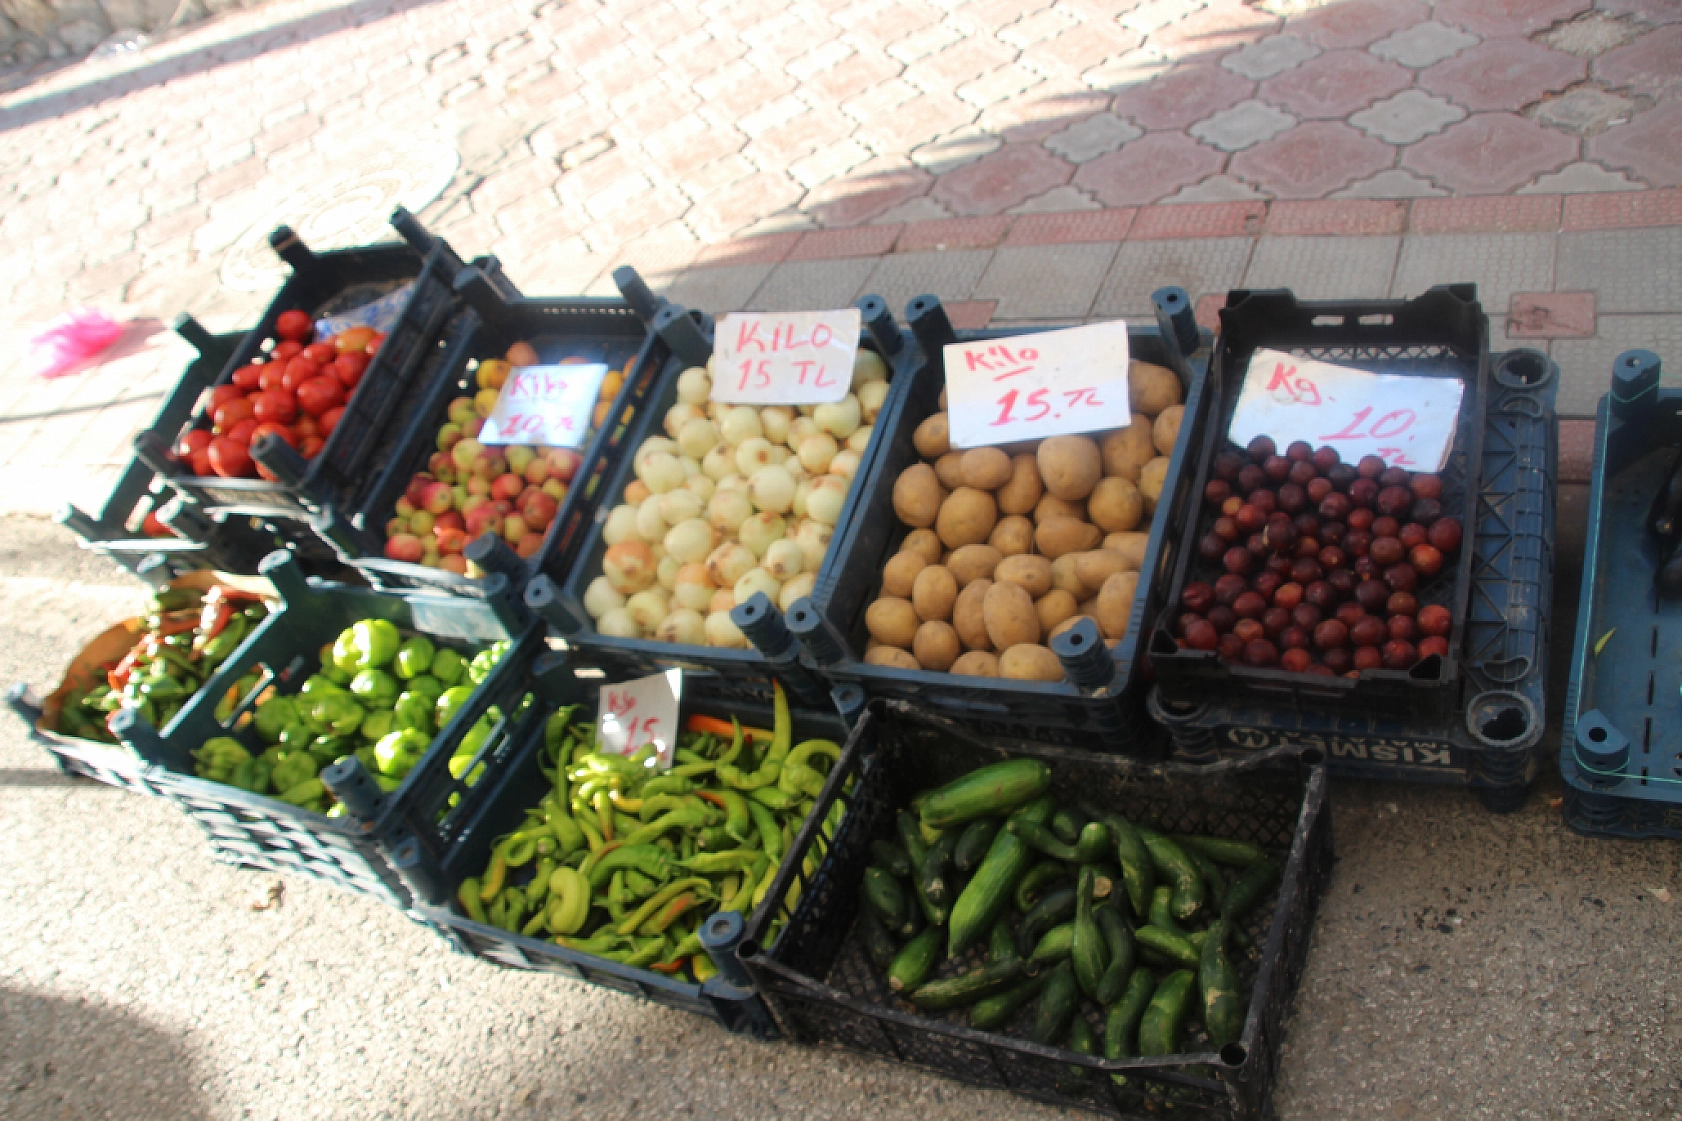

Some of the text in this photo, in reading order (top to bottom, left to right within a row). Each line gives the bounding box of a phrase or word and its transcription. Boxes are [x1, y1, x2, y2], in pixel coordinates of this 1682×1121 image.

[738, 358, 837, 391] 15 TL
[499, 414, 544, 437] 10
